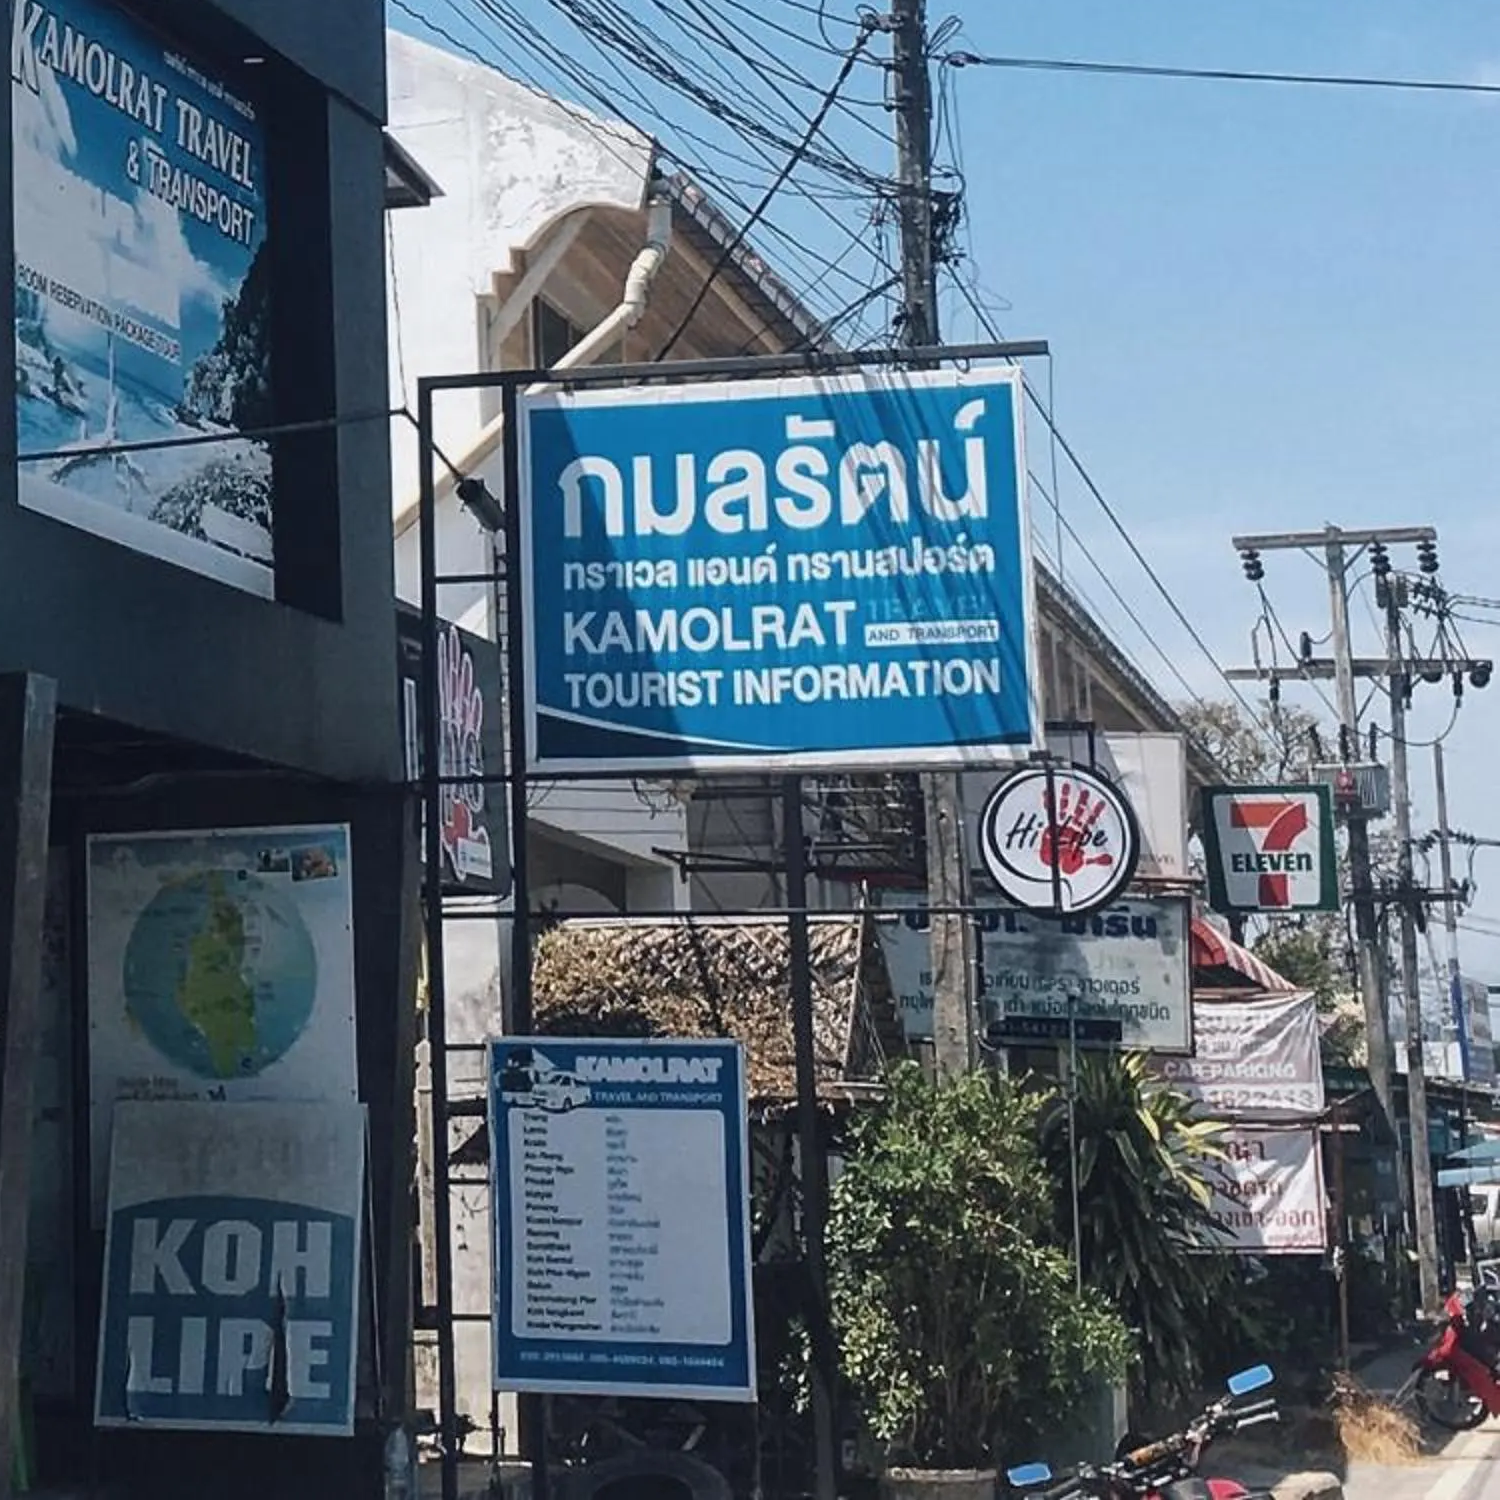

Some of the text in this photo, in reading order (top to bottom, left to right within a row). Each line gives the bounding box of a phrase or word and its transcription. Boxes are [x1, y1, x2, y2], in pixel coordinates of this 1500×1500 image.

[175, 96, 254, 190] TRAVEL
[126, 140, 254, 246] & TRANSPORT
[557, 400, 988, 538] กมลรัตน์
[564, 533, 995, 589] ทราเวล แอนด์ ทรานสปอร์ต
[564, 601, 856, 654] KAMOLRAT
[867, 624, 997, 642] AND TRANSPORT
[564, 658, 1000, 708] TOURIST INFORMATION
[1005, 812, 1043, 849] Hi
[128, 1217, 333, 1298] KOH
[124, 1316, 333, 1399] LIPE
